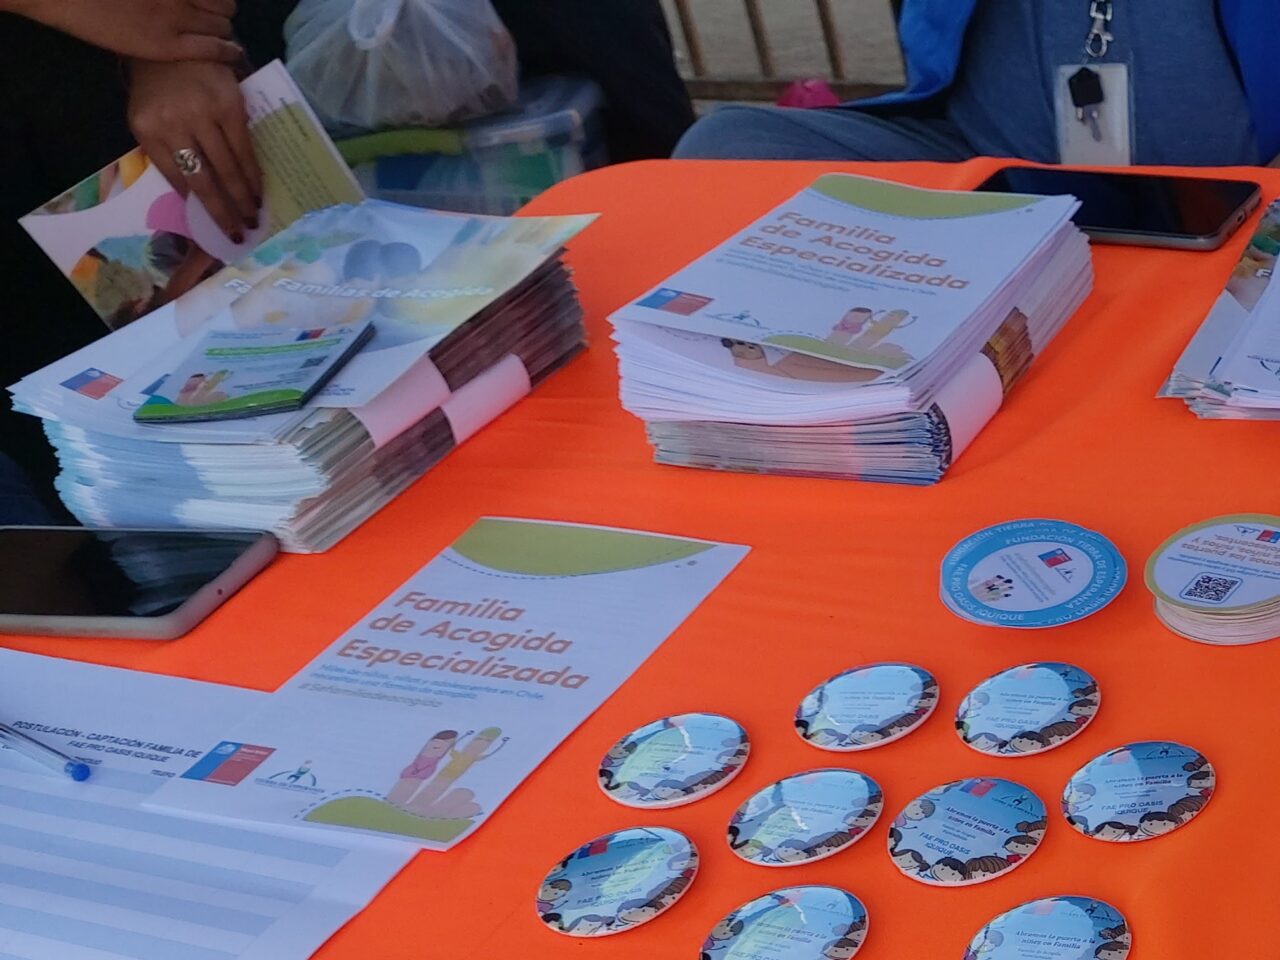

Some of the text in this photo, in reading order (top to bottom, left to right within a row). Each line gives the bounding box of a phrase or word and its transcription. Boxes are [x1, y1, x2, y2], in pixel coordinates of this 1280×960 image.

[777, 212, 896, 244] Familia
[760, 223, 947, 268] de Acogida
[739, 236, 971, 290] Especializada
[273, 277, 371, 298] Familias
[393, 591, 526, 622] Familia
[368, 612, 574, 655] de Acogida
[336, 638, 590, 690] Especializada
[87, 731, 142, 749] CAPTACIÓN
[142, 740, 184, 758] FAMILIA
[184, 749, 204, 761] DE
[948, 843, 971, 856] OASIS
